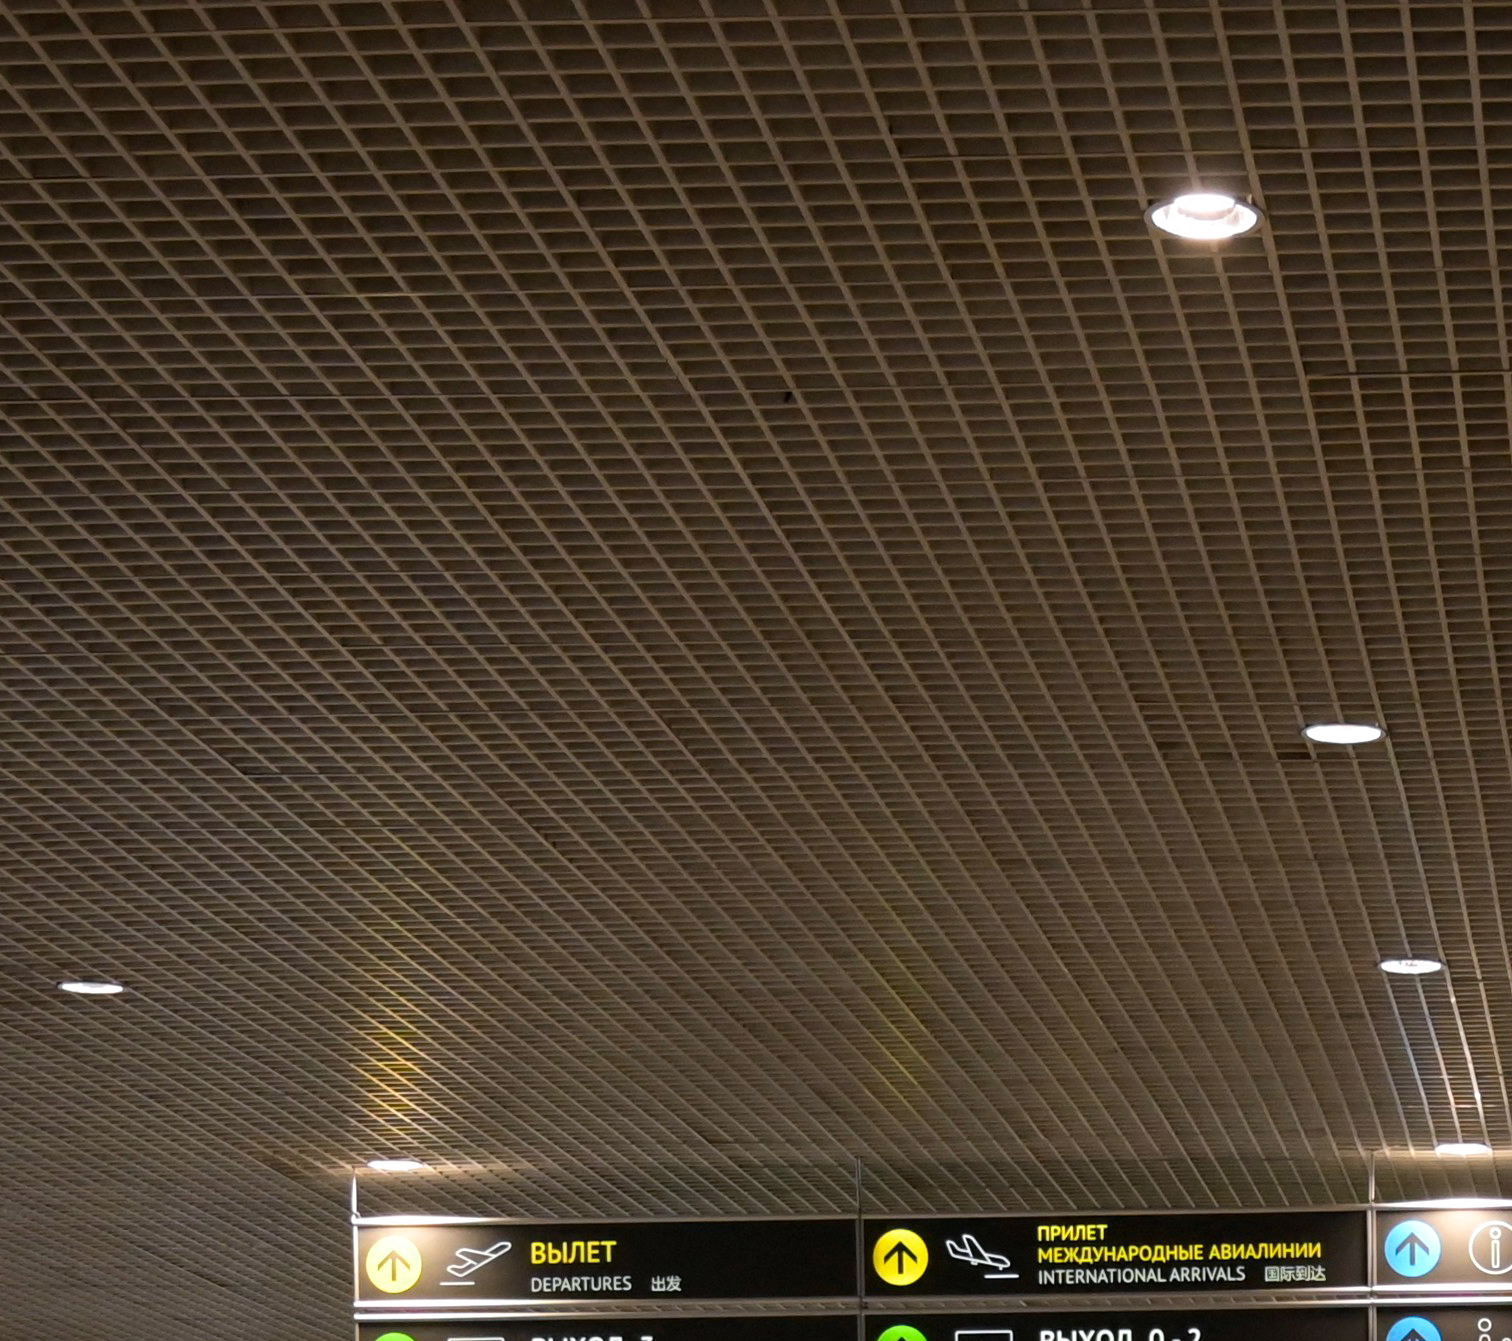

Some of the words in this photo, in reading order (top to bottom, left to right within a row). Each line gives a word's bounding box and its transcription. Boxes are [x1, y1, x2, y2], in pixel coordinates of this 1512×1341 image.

[1037, 1225, 1107, 1242] ПРИЛЕТ
[530, 1241, 617, 1264] ВЫЛЕТ
[1038, 1244, 1203, 1264] МЕЖДУНАРОДНЫЕ
[1209, 1242, 1321, 1259] АВИАЛИНИИ
[531, 1276, 632, 1292] DEPARTURES
[651, 1276, 682, 1291] 出发
[1038, 1268, 1167, 1284] INTERNATIONAL
[1169, 1266, 1245, 1282] ARRIVALS
[1265, 1266, 1326, 1282] 国际到达
